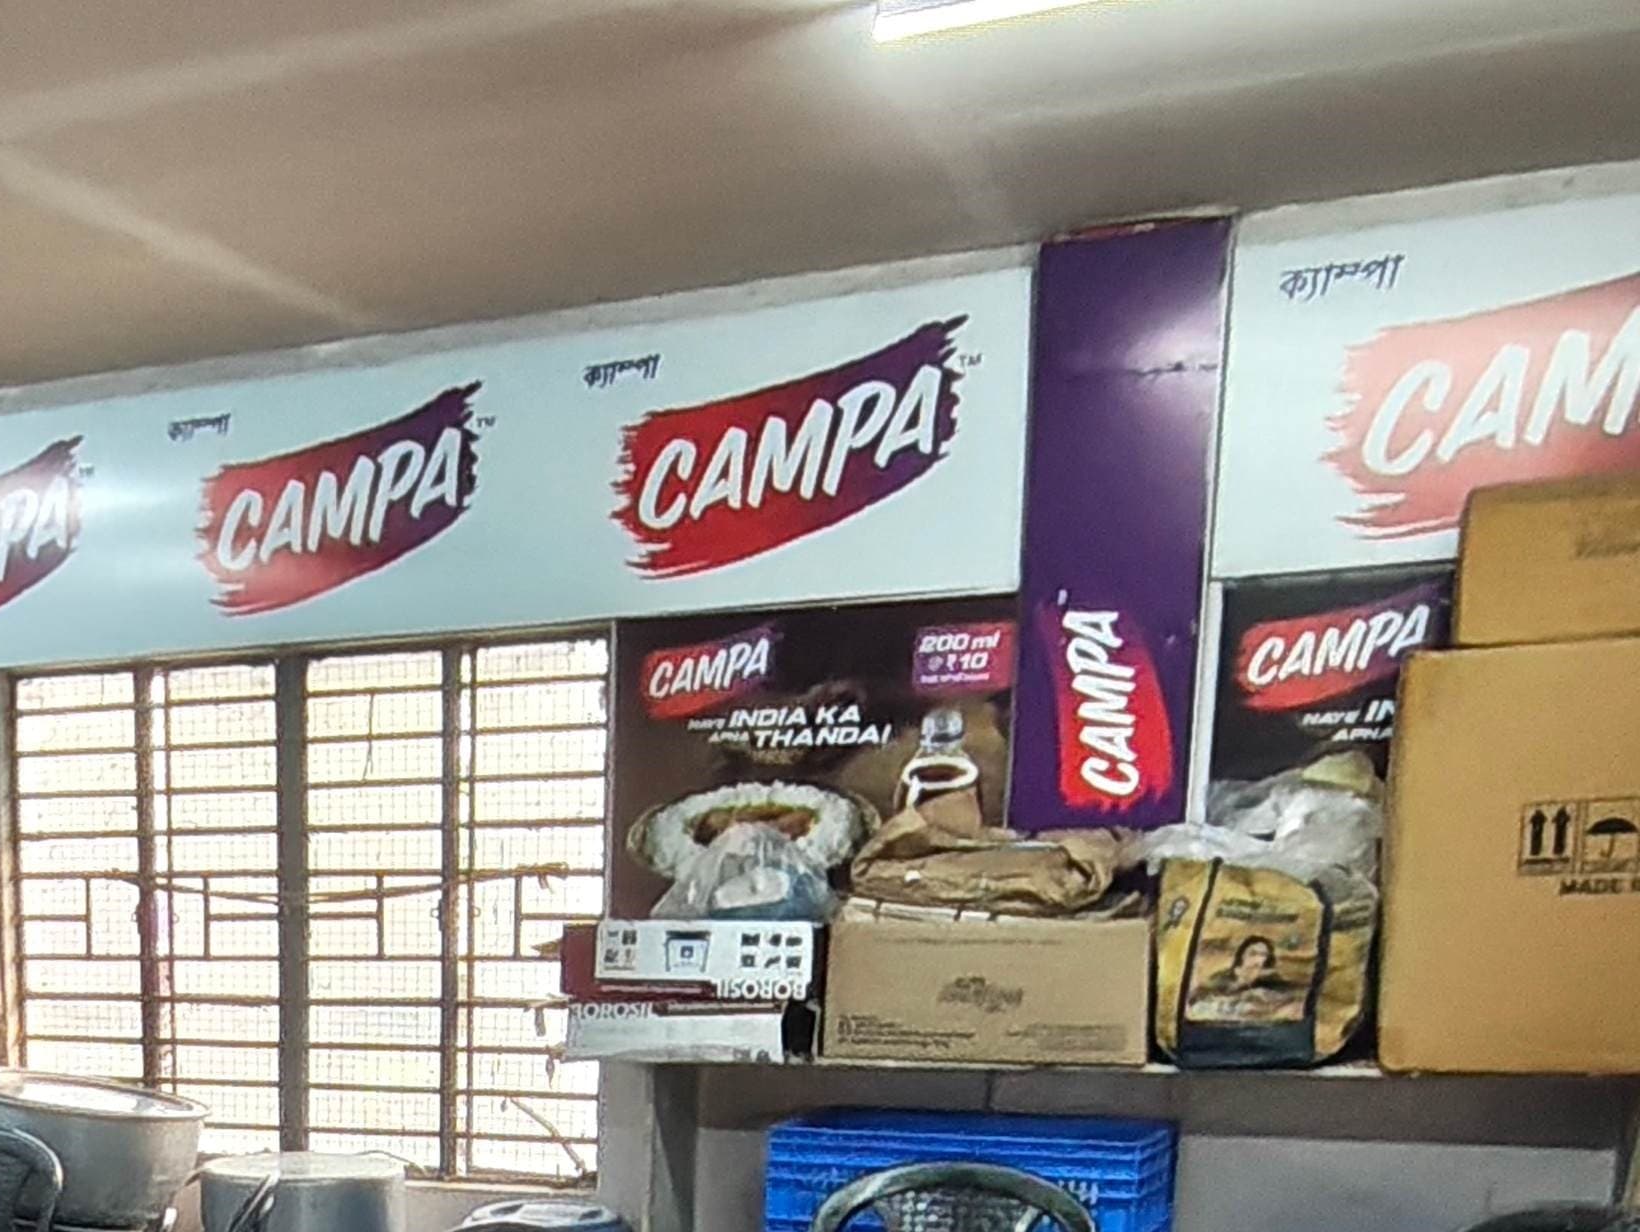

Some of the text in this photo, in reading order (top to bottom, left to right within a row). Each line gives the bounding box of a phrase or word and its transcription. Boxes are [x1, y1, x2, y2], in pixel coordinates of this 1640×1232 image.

[638, 364, 940, 530] CAMPA
[217, 427, 459, 571] CAMPA
[649, 638, 770, 698] CAMPA
[919, 630, 1001, 653] 200 ml
[1247, 605, 1430, 685] CAMPA
[728, 708, 807, 729] INDIA
[815, 704, 861, 725] KA
[754, 724, 893, 748] THANDAI
[1063, 608, 1139, 797] CAMPA
